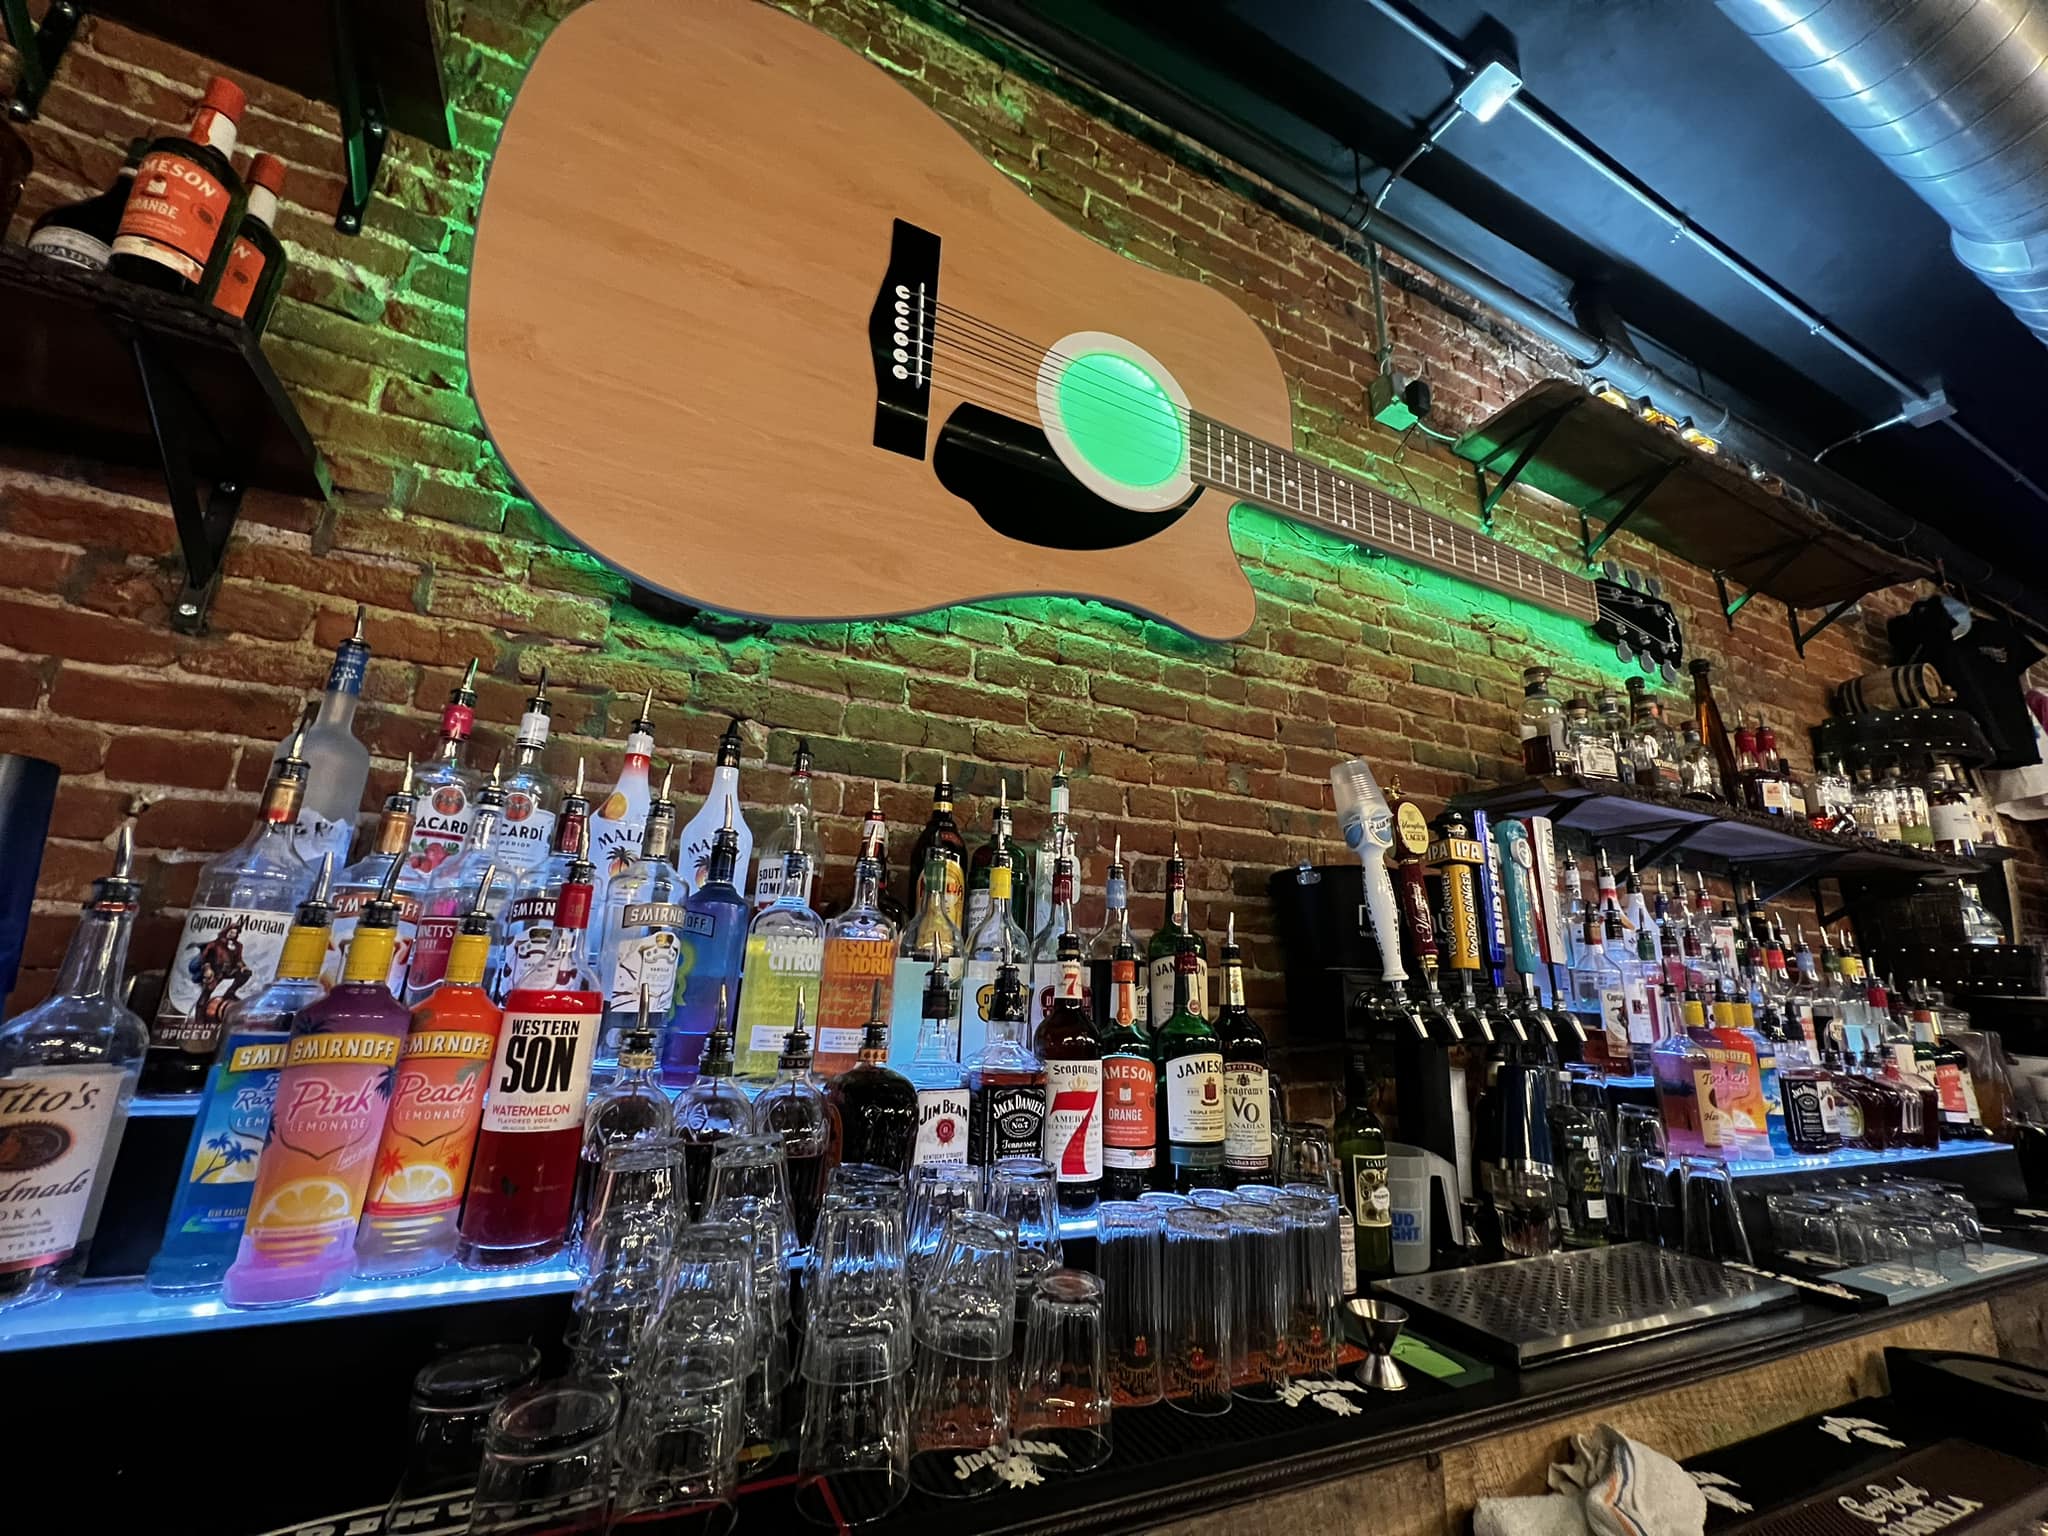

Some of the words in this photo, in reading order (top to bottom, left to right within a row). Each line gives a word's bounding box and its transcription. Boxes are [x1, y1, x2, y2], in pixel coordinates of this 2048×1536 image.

[143, 157, 217, 198] MESON
[416, 816, 469, 835] ACARD
[500, 824, 545, 841] CARDÍ
[597, 829, 643, 851] MALI
[1455, 841, 1481, 860] IPA
[759, 867, 781, 881] SOUT
[512, 902, 557, 918] SMIRN
[630, 906, 686, 923] SMIRNO
[190, 913, 232, 930] Captain
[237, 914, 286, 936] Morgan
[1466, 913, 1481, 958] VOODOO
[1063, 973, 1078, 996] 7
[512, 1019, 580, 1036] WESTERN
[293, 1038, 395, 1062] SMIRNOFF
[402, 1034, 490, 1056] SMIRNOFF
[500, 1036, 579, 1094] SON
[1103, 1065, 1154, 1084] AMESON
[1176, 1060, 1224, 1079] JAMES
[288, 1077, 373, 1123] Pink
[395, 1071, 477, 1110] Peach
[399, 1107, 468, 1122] LEMONADE
[492, 1103, 571, 1117] WATERMELON
[919, 1103, 941, 1126] JIM
[944, 1099, 969, 1122] BEAM
[992, 1098, 1016, 1120] JACK
[1108, 1108, 1143, 1121] ORANGE
[289, 1117, 367, 1132] LEMONADE
[1049, 1088, 1099, 1175] 7
[0, 1168, 91, 1204] dmade
[1391, 1213, 1415, 1226] UD
[1391, 1226, 1420, 1240] GHT
[954, 1449, 996, 1481] JIM
